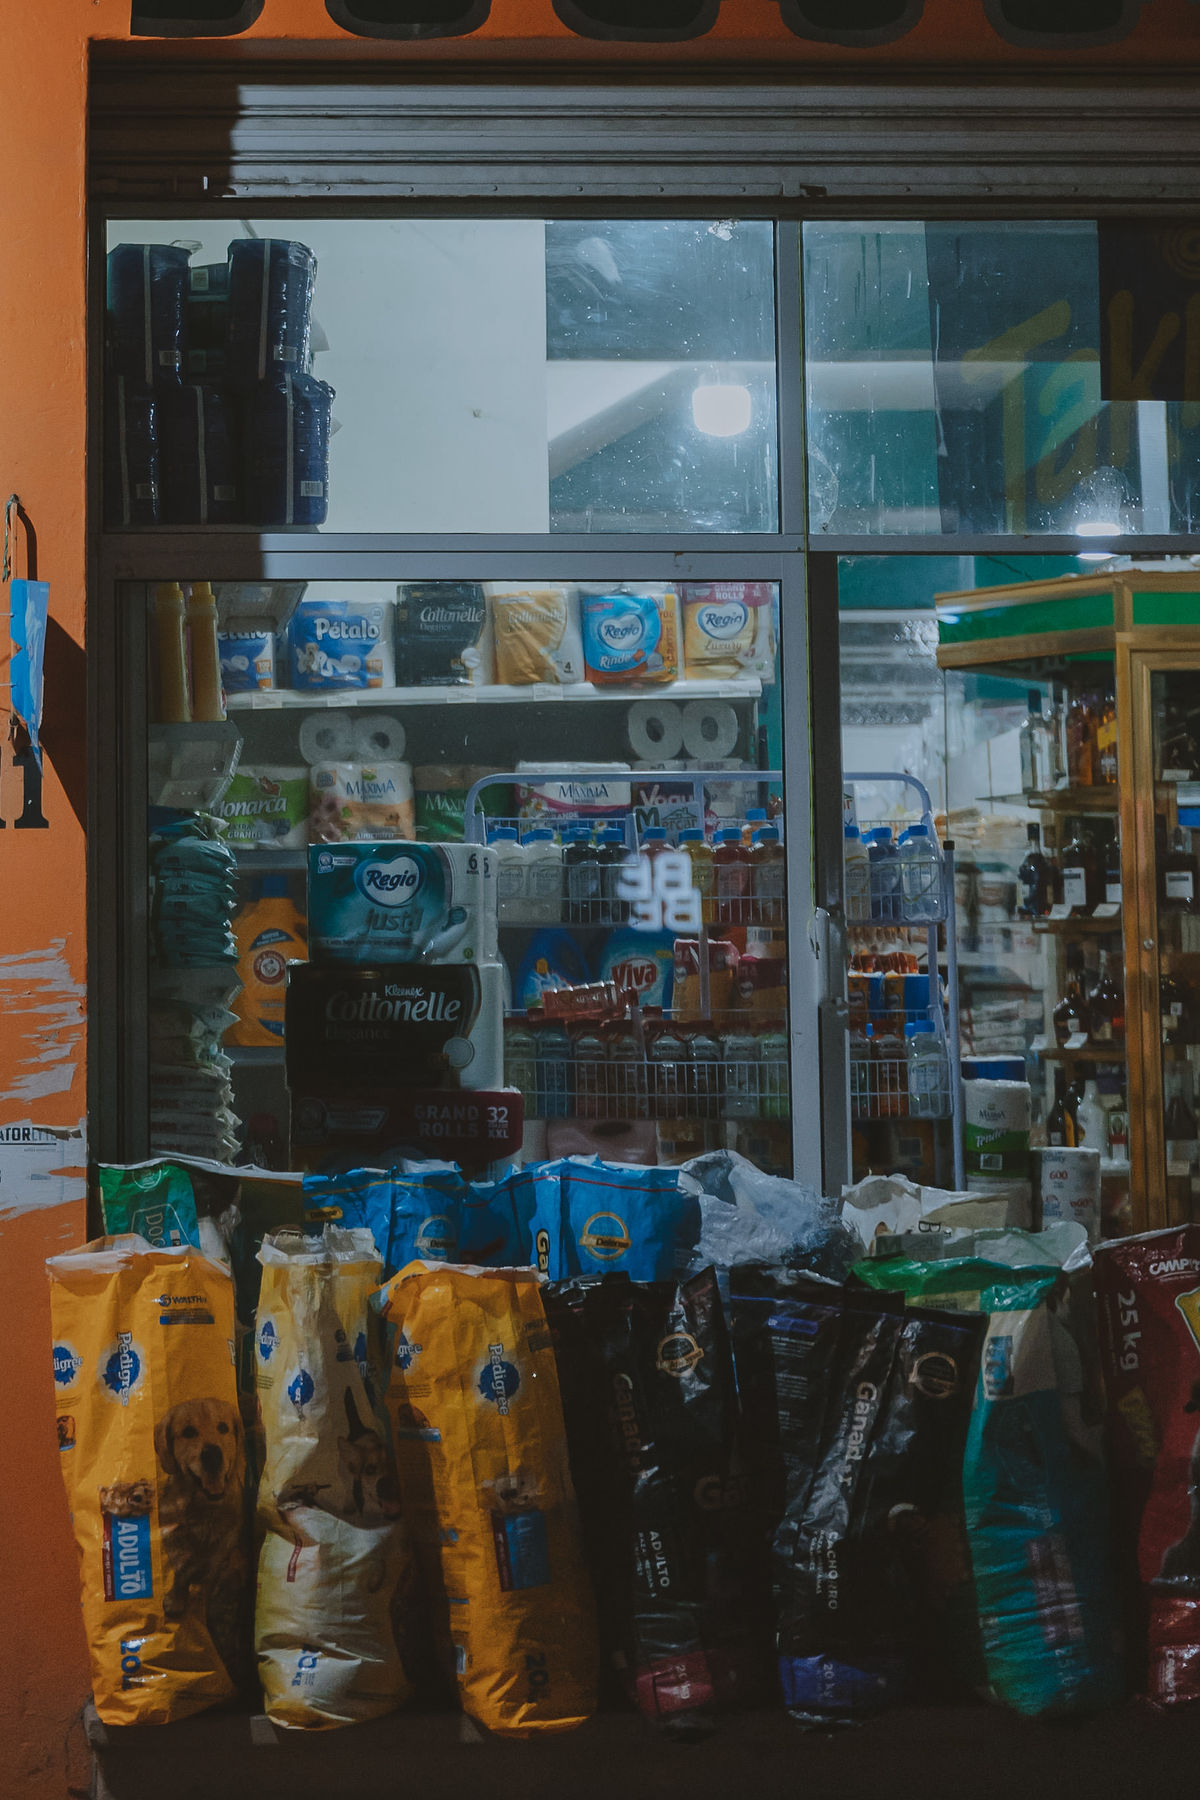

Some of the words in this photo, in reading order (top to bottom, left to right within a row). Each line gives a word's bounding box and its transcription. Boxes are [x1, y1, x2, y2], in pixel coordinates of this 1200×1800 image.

[314, 618, 380, 641] Pétalo
[604, 622, 641, 638] Regio
[705, 613, 744, 628] Regio
[468, 853, 478, 870] 6
[365, 870, 417, 892] Regio
[611, 961, 658, 989] Viva
[325, 991, 462, 1022] Cottonelle
[414, 1104, 480, 1120] GRAND
[488, 1105, 509, 1121] 32
[420, 1121, 479, 1137] ROLLS
[1116, 1291, 1139, 1331] 25
[1119, 1333, 1140, 1372] kg
[116, 1331, 134, 1407] Pedigree
[489, 1342, 509, 1416] Pedigree
[116, 1521, 140, 1596] ADULTO
[649, 1530, 671, 1588] ADULTO
